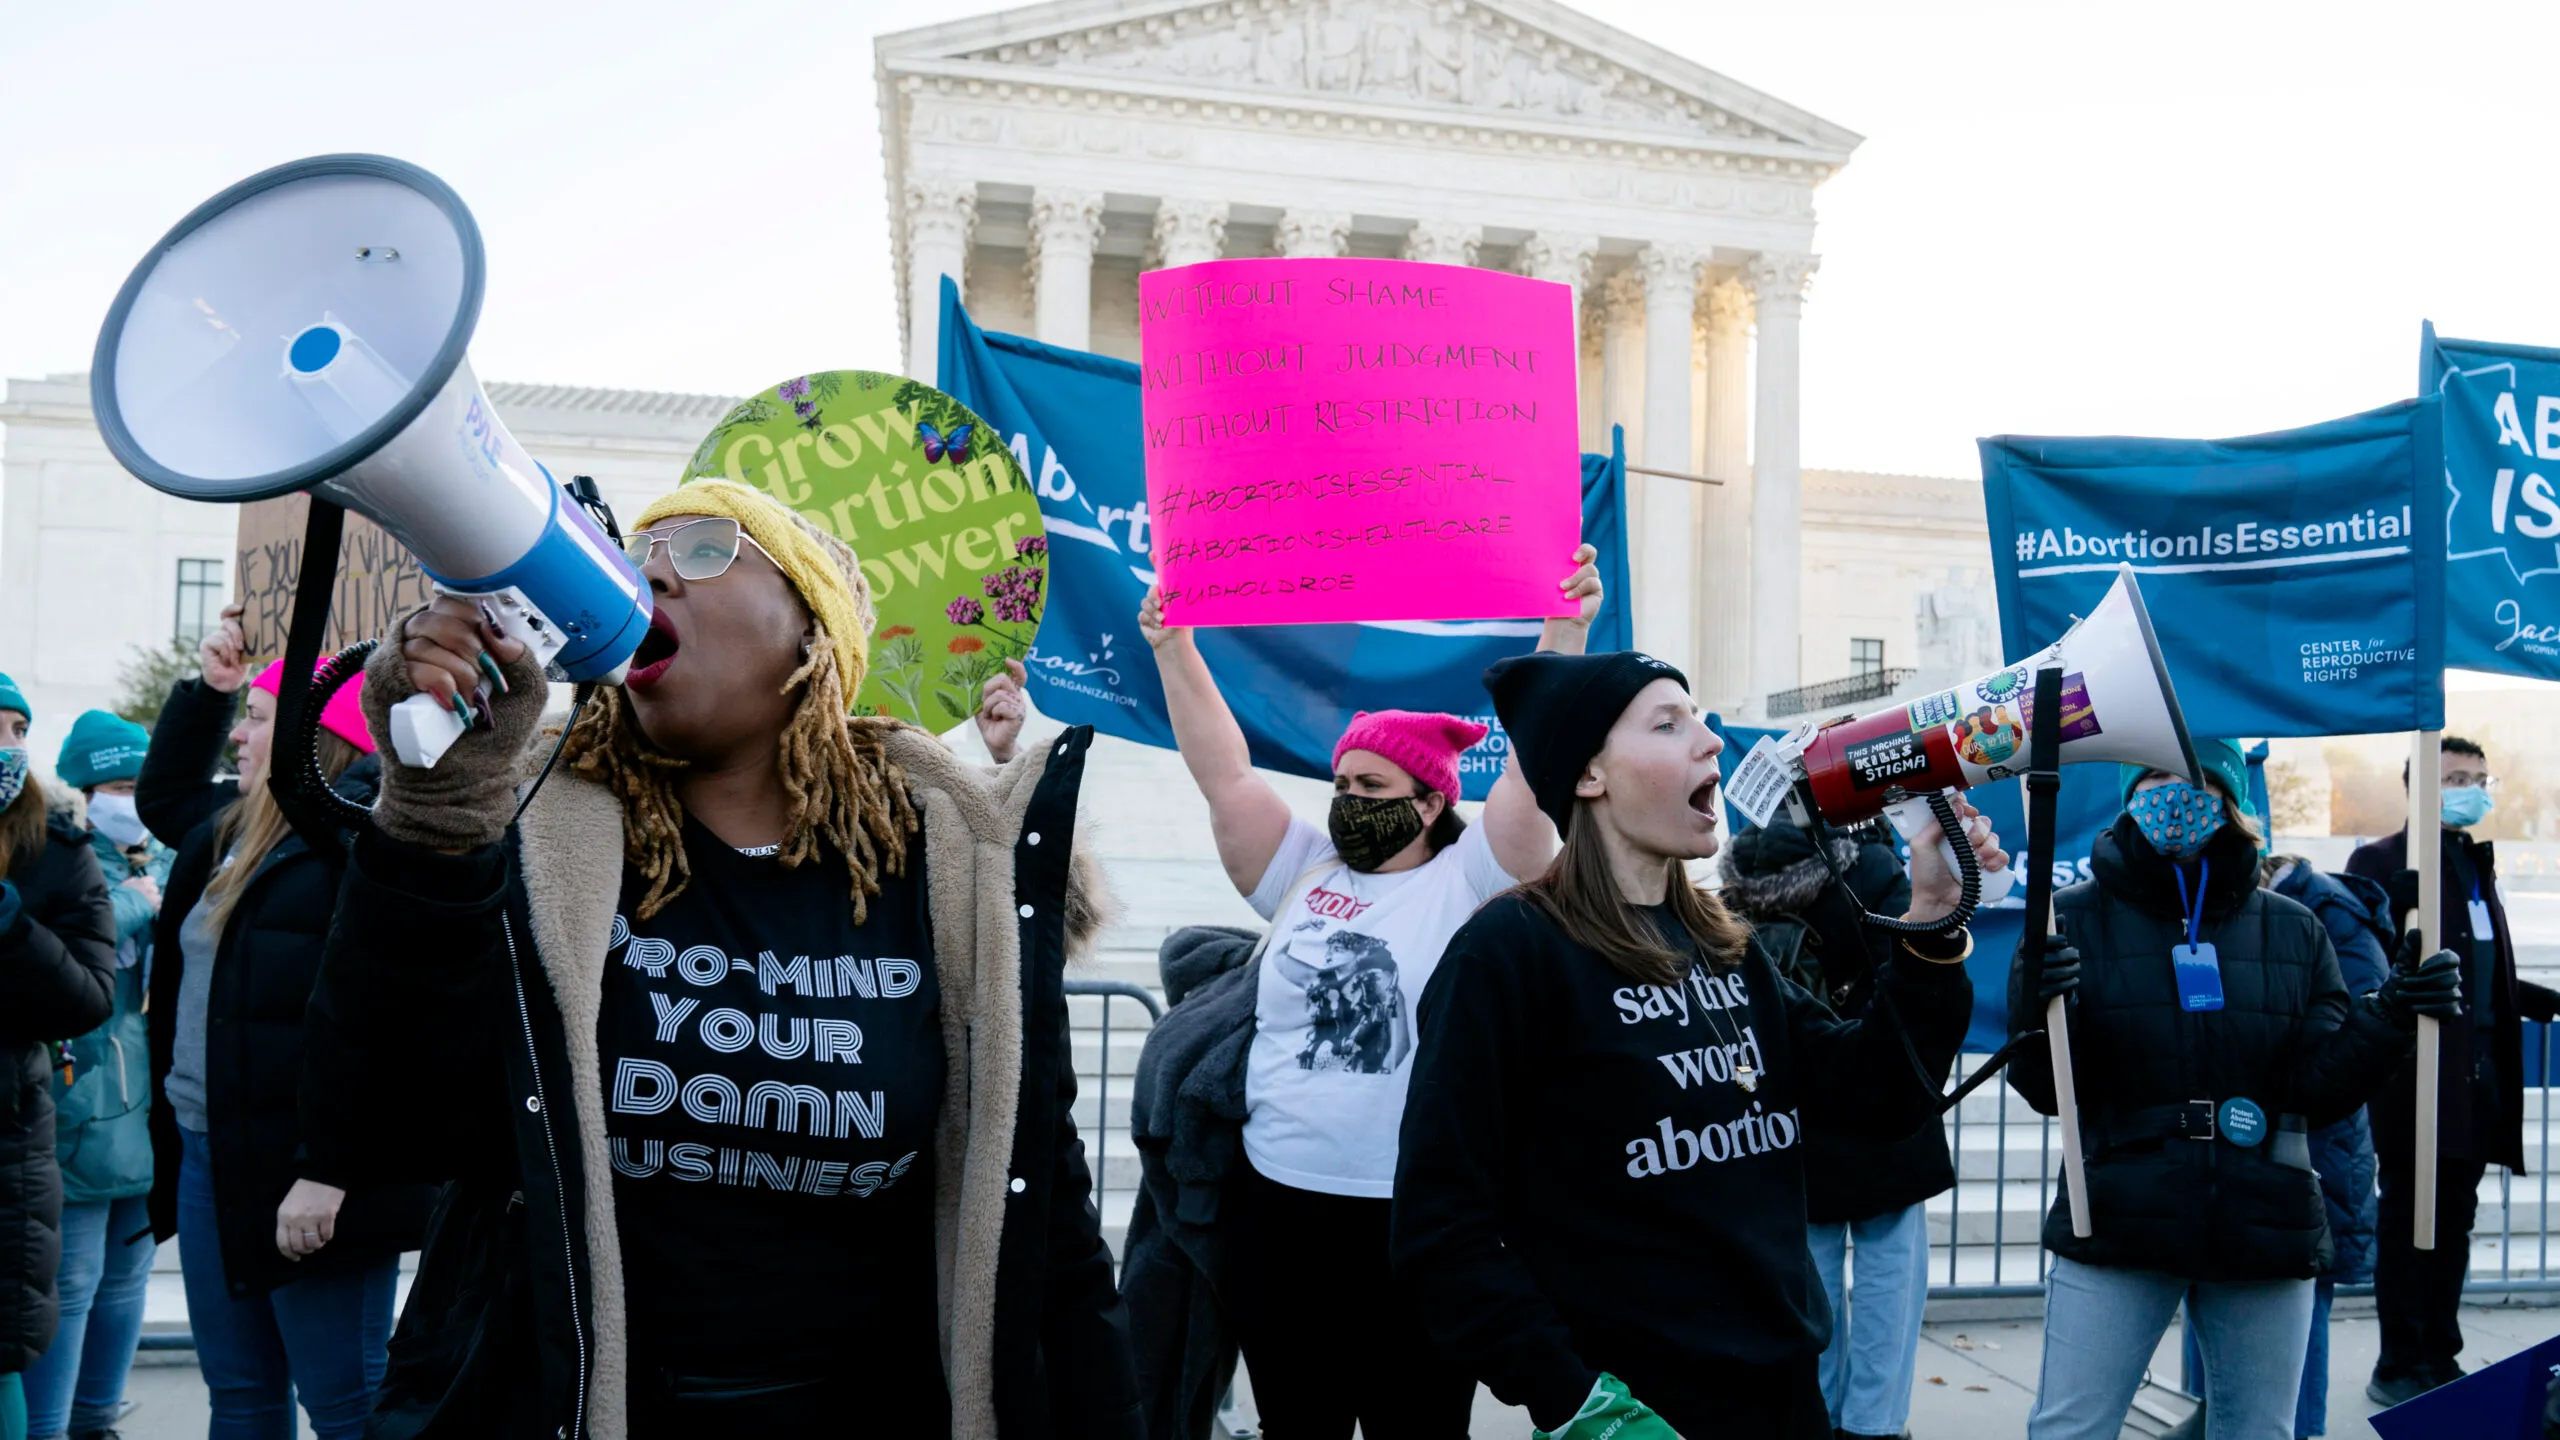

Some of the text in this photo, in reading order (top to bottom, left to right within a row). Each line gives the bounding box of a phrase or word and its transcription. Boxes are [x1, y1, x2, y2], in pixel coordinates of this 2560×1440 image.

[1144, 278, 1448, 322] WITHOUT SHAME
[1145, 343, 1541, 391] WITHOUT JUDGMENT
[1148, 397, 1536, 448] WITHOUT RESTRICTION
[724, 399, 920, 506] Grow
[798, 452, 1013, 542] ortion
[1158, 462, 1514, 526] #ABORTIONISESSENTIAL
[860, 511, 1027, 602] ower
[1164, 515, 1514, 569] #ABORTIONISHEALTHCARE
[2016, 505, 2411, 562] #AbortionIsEssential
[1163, 574, 1355, 607] #UPHOLDROE
[2300, 637, 2385, 655] CENTER for
[2495, 599, 2560, 651] Jac
[2302, 648, 2415, 669] REPRODUCTIVE
[2303, 667, 2357, 682] RIGHTS
[1049, 676, 1138, 708] ORGANIZATION
[1848, 735, 1912, 760] THIS MACHINE
[1855, 744, 1912, 770] KILLS
[1865, 755, 1926, 782] STIGMA
[1612, 964, 1749, 1027] say the
[649, 991, 863, 1064] YOUR
[1656, 1026, 1766, 1089] word
